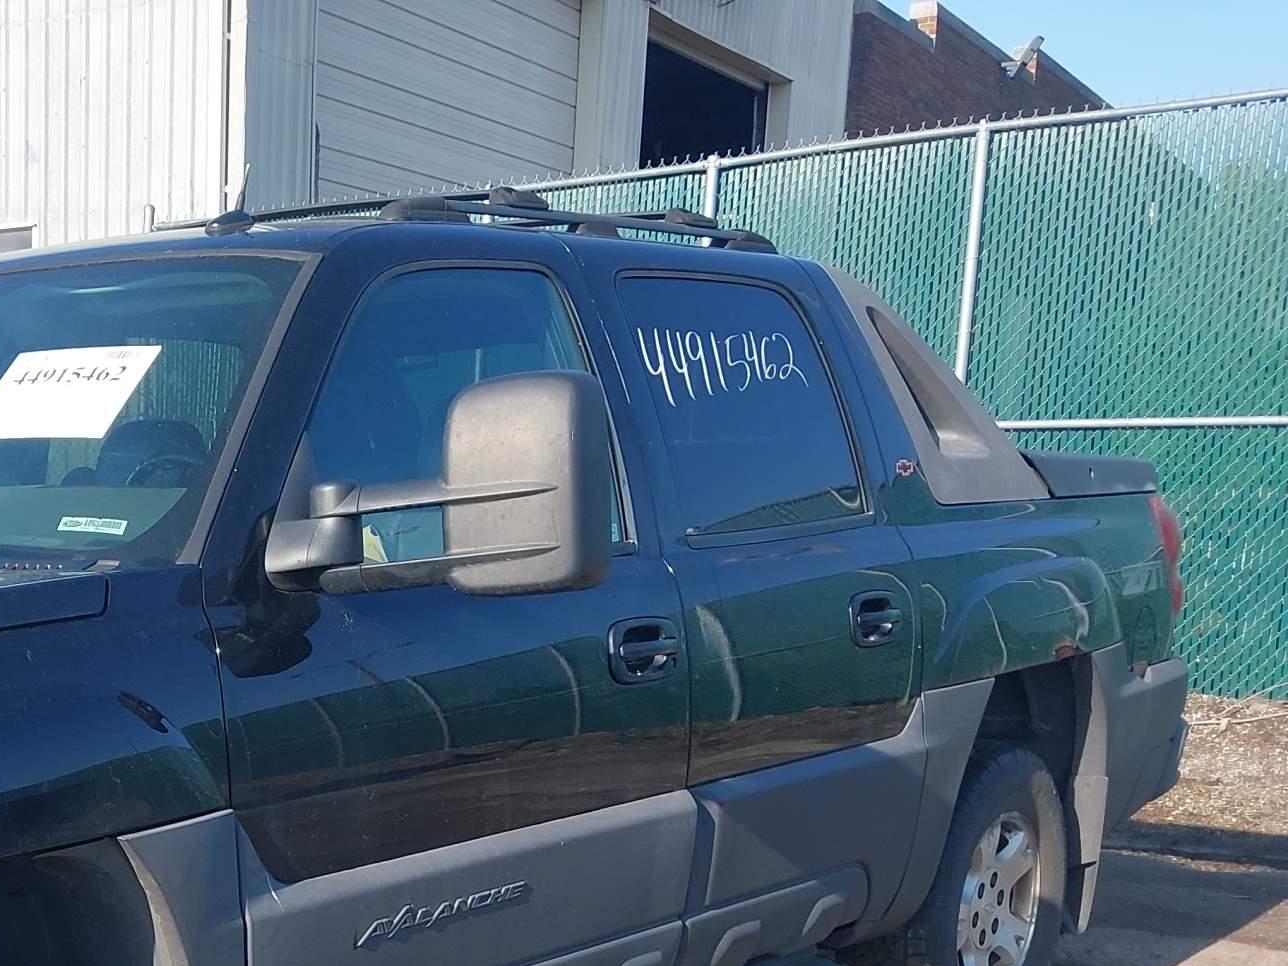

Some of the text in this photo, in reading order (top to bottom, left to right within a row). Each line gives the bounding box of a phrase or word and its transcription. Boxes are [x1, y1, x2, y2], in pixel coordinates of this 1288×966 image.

[14, 365, 127, 385] 44915462
[637, 327, 809, 408] 44915462
[355, 880, 528, 950] AVALANCHE
